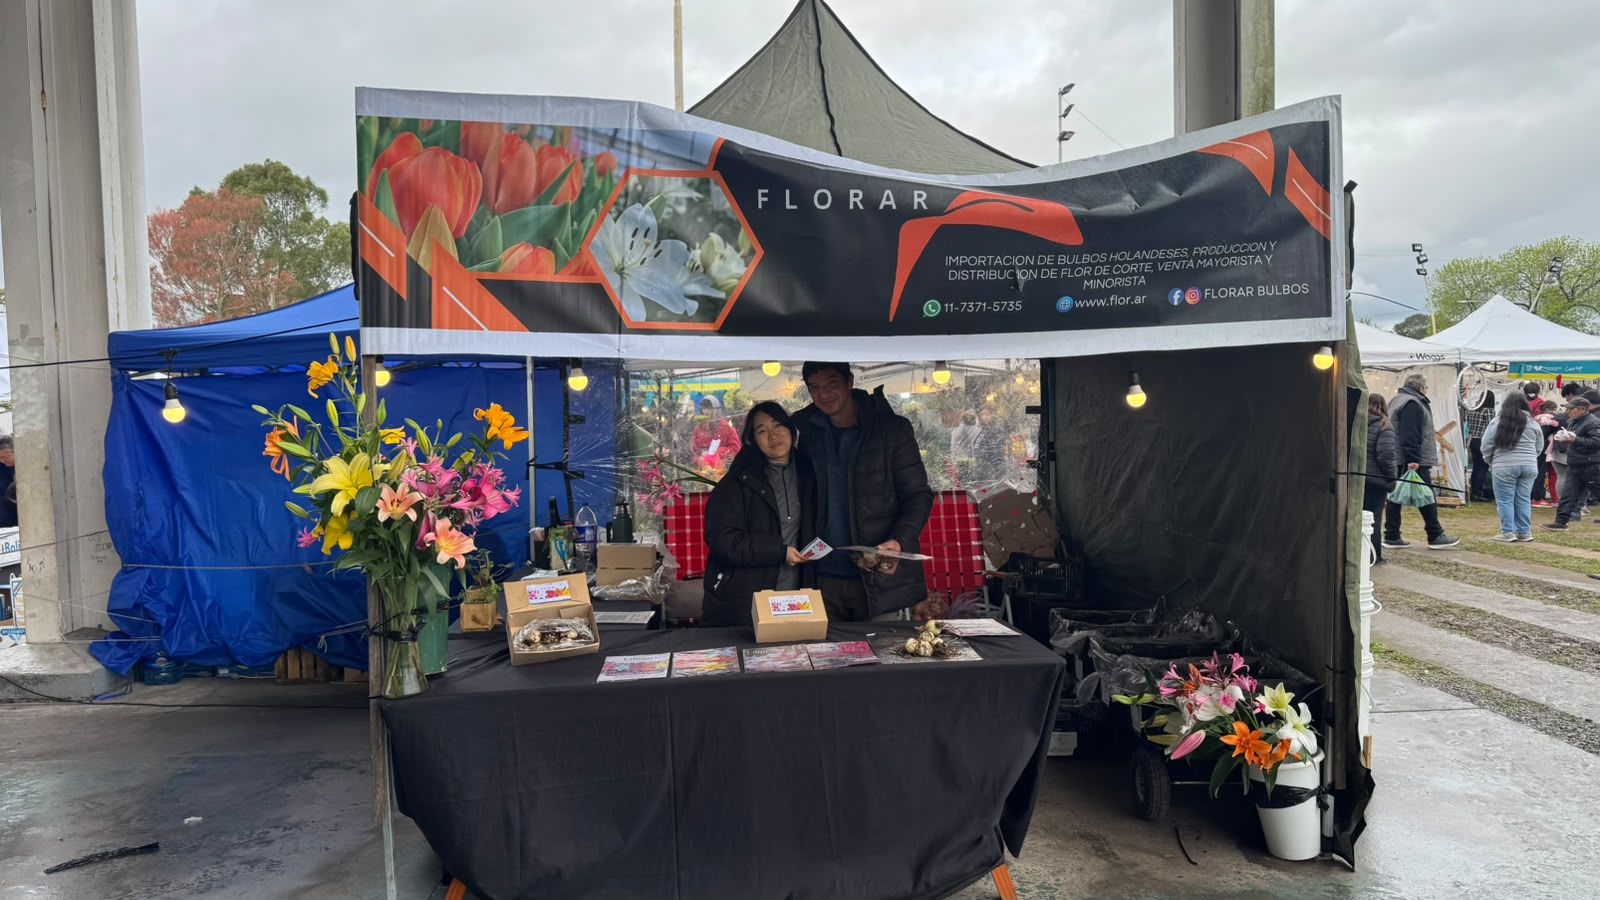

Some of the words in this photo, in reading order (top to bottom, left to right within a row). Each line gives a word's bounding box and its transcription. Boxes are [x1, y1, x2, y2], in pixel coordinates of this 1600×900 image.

[757, 188, 928, 210] FLORAR
[945, 255, 1034, 267] IMPORTACION
[1037, 254, 1055, 265] DE
[1057, 252, 1108, 265] BULBOS
[1109, 247, 1190, 262] HOLANDESES,
[1192, 241, 1267, 257] PRODUCCION
[1269, 240, 1277, 251] Y
[948, 268, 1038, 281] DISTRIBUCION
[1040, 268, 1058, 279] DE
[1060, 266, 1092, 279] FLOR
[1094, 265, 1111, 276] DE
[1112, 262, 1154, 275] CORTE,
[1157, 259, 1195, 272] VENTA
[1196, 255, 1263, 268] MAYORISTA
[1264, 254, 1273, 265] Y
[1083, 275, 1147, 291] MINORISTA
[1204, 286, 1254, 299] FLORAR
[1257, 283, 1310, 297] BULBOS
[943, 300, 1023, 313] 11-7371-5735
[1075, 294, 1147, 308] www.flor.ar
